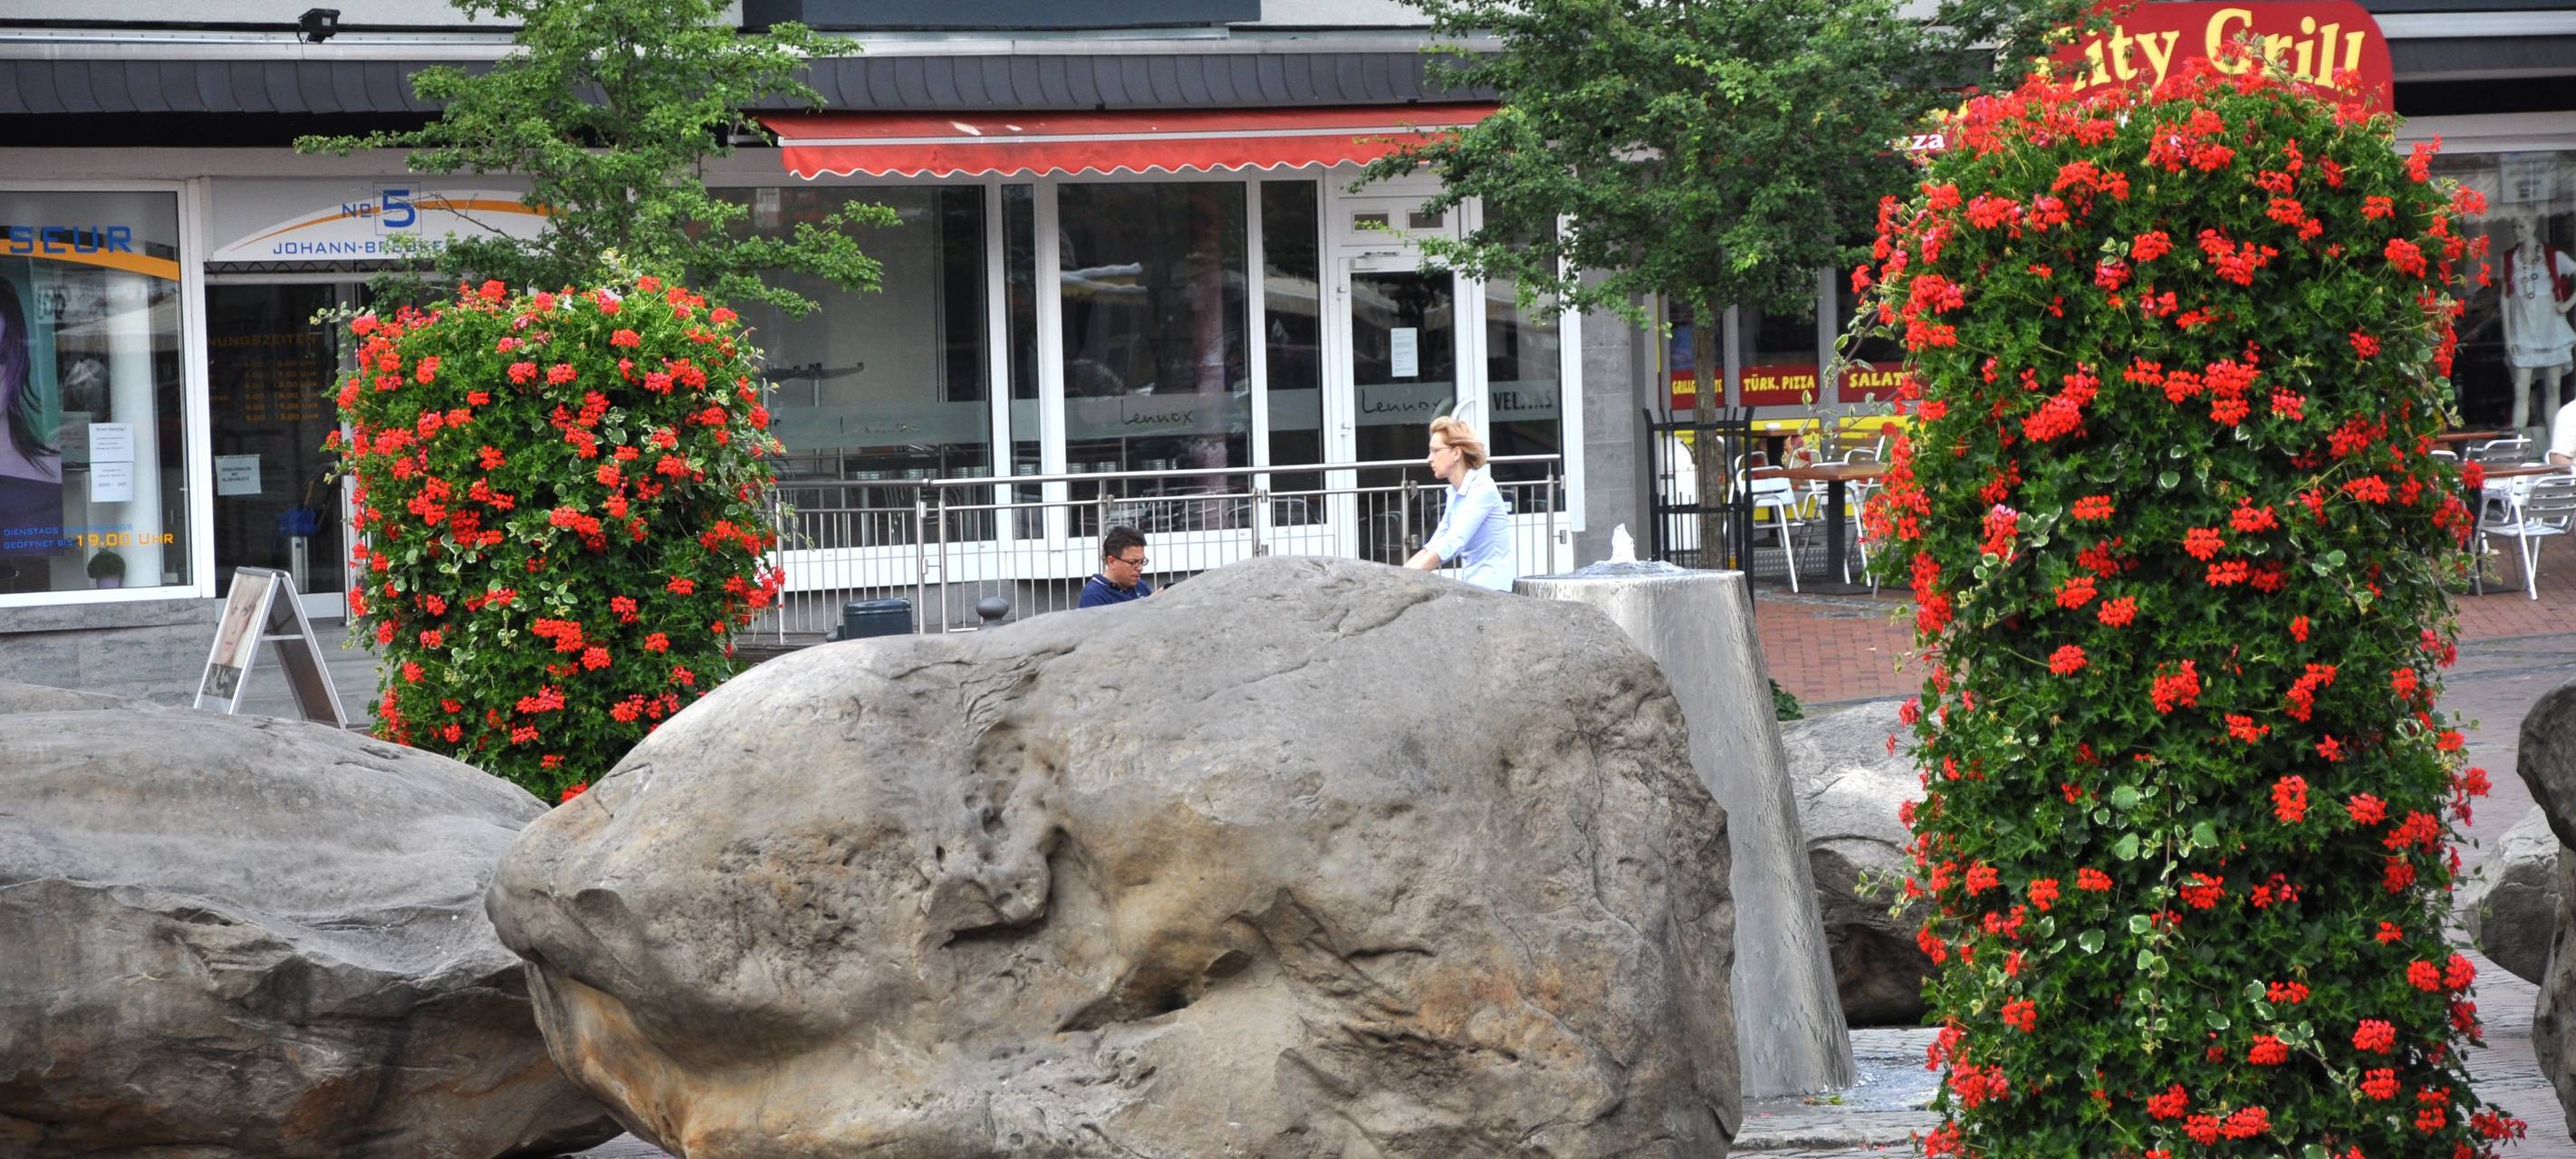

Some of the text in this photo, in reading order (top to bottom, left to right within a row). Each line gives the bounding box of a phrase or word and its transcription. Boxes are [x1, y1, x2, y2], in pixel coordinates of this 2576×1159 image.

[2205, 7, 2365, 96] Grill
[381, 189, 416, 228] 5
[8, 225, 133, 254] SEUR
[1744, 373, 1816, 392] TÜRK. PIZZA
[1849, 371, 1913, 388] SALAT
[1120, 398, 1193, 426] Lennox
[4, 527, 59, 536] DIENSTAGS
[139, 532, 174, 546] UHR
